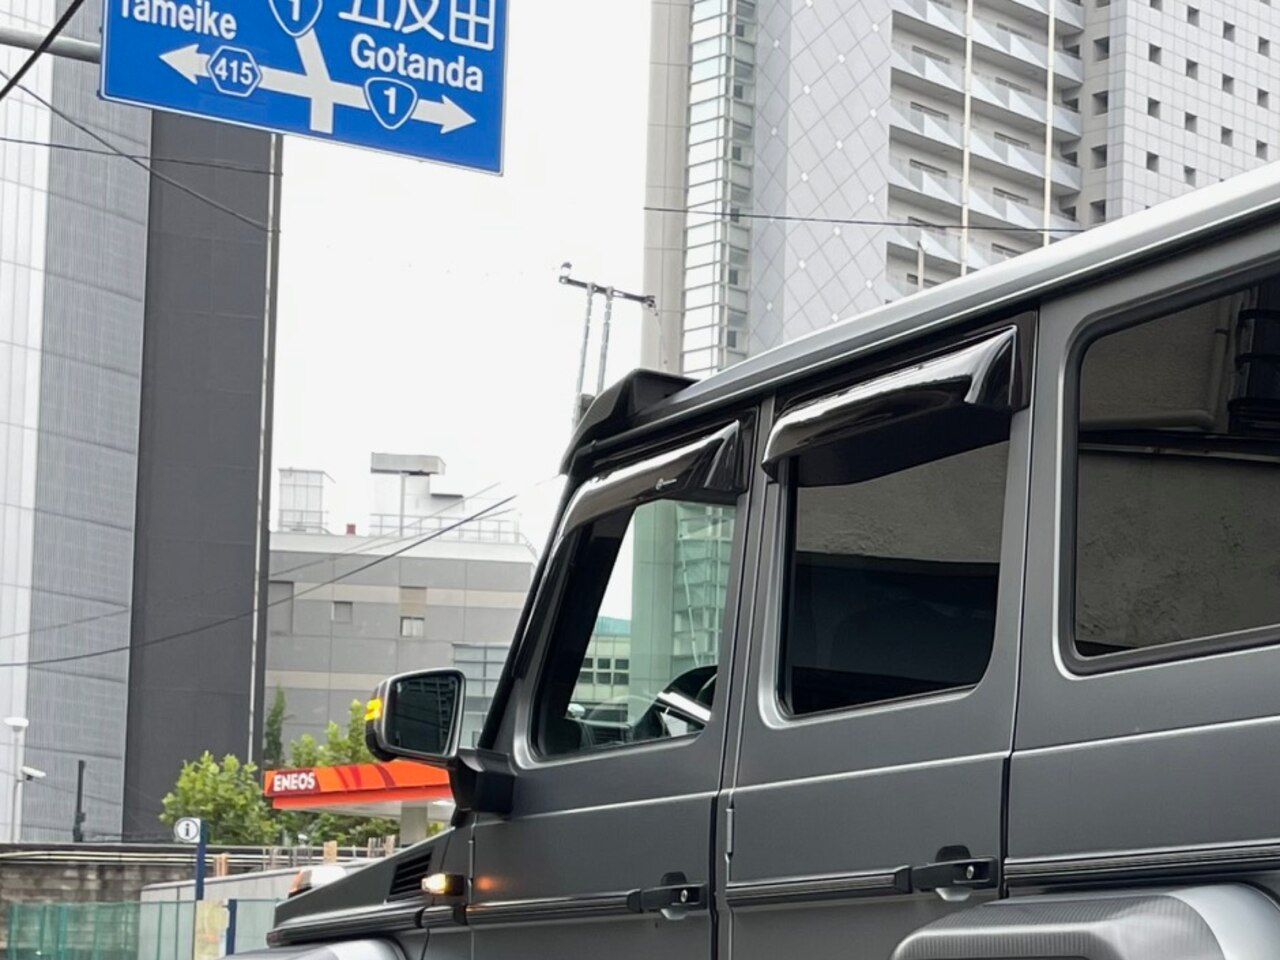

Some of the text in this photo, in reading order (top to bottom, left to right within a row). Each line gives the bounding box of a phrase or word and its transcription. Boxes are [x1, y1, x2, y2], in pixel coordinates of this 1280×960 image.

[213, 57, 253, 86] 415
[350, 33, 484, 93] Gotanda
[383, 86, 397, 115] 1
[272, 771, 317, 792] ENEOS
